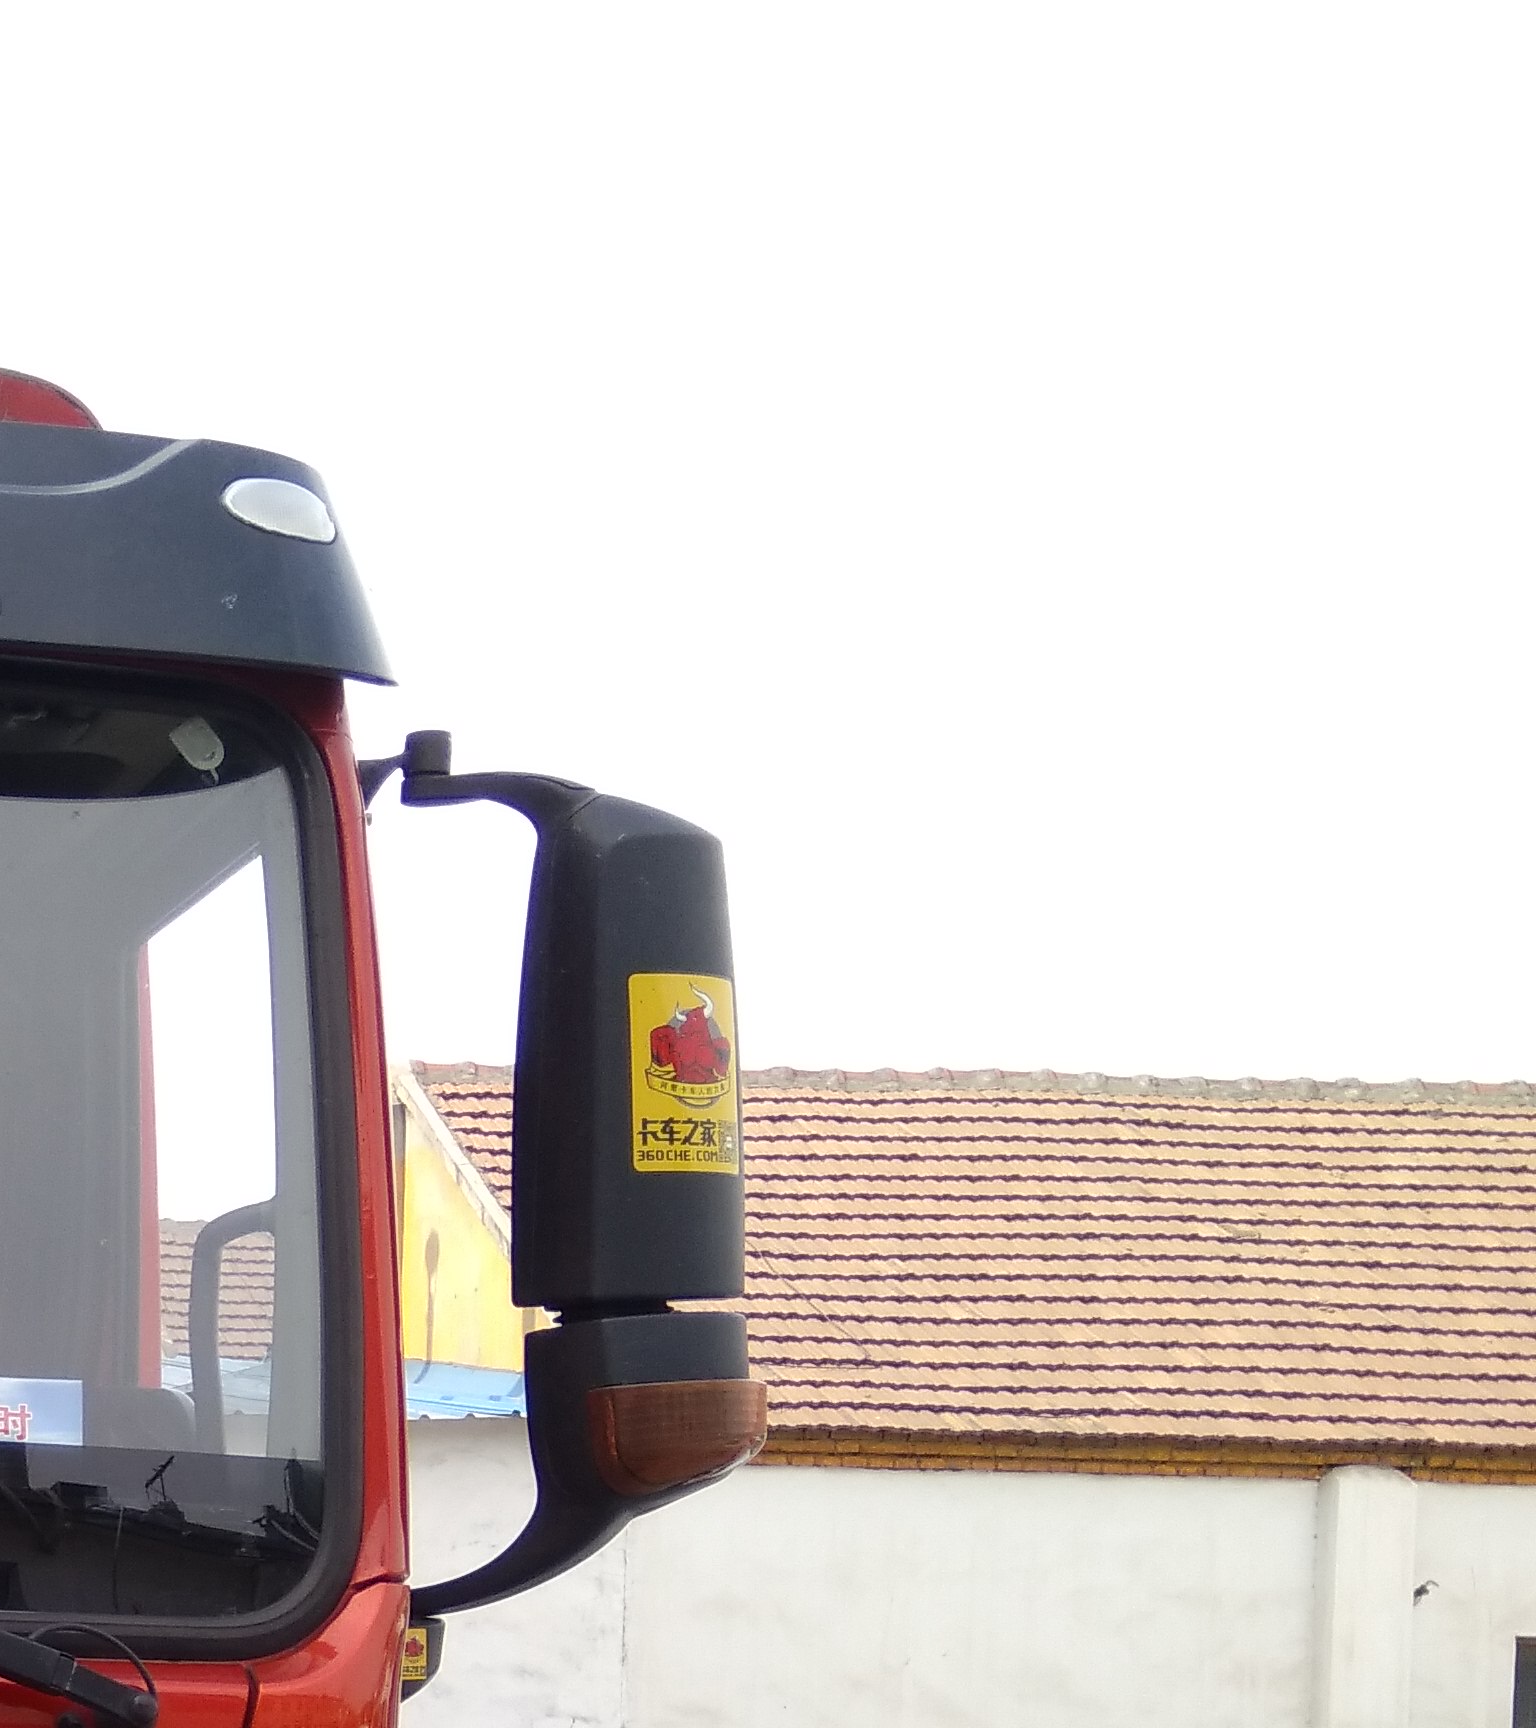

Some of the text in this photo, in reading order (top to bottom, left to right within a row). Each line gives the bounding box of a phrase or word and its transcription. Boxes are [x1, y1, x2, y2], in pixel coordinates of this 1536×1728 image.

[637, 1116, 717, 1148] 卡车之家
[637, 1149, 718, 1163] 360CHE.COM
